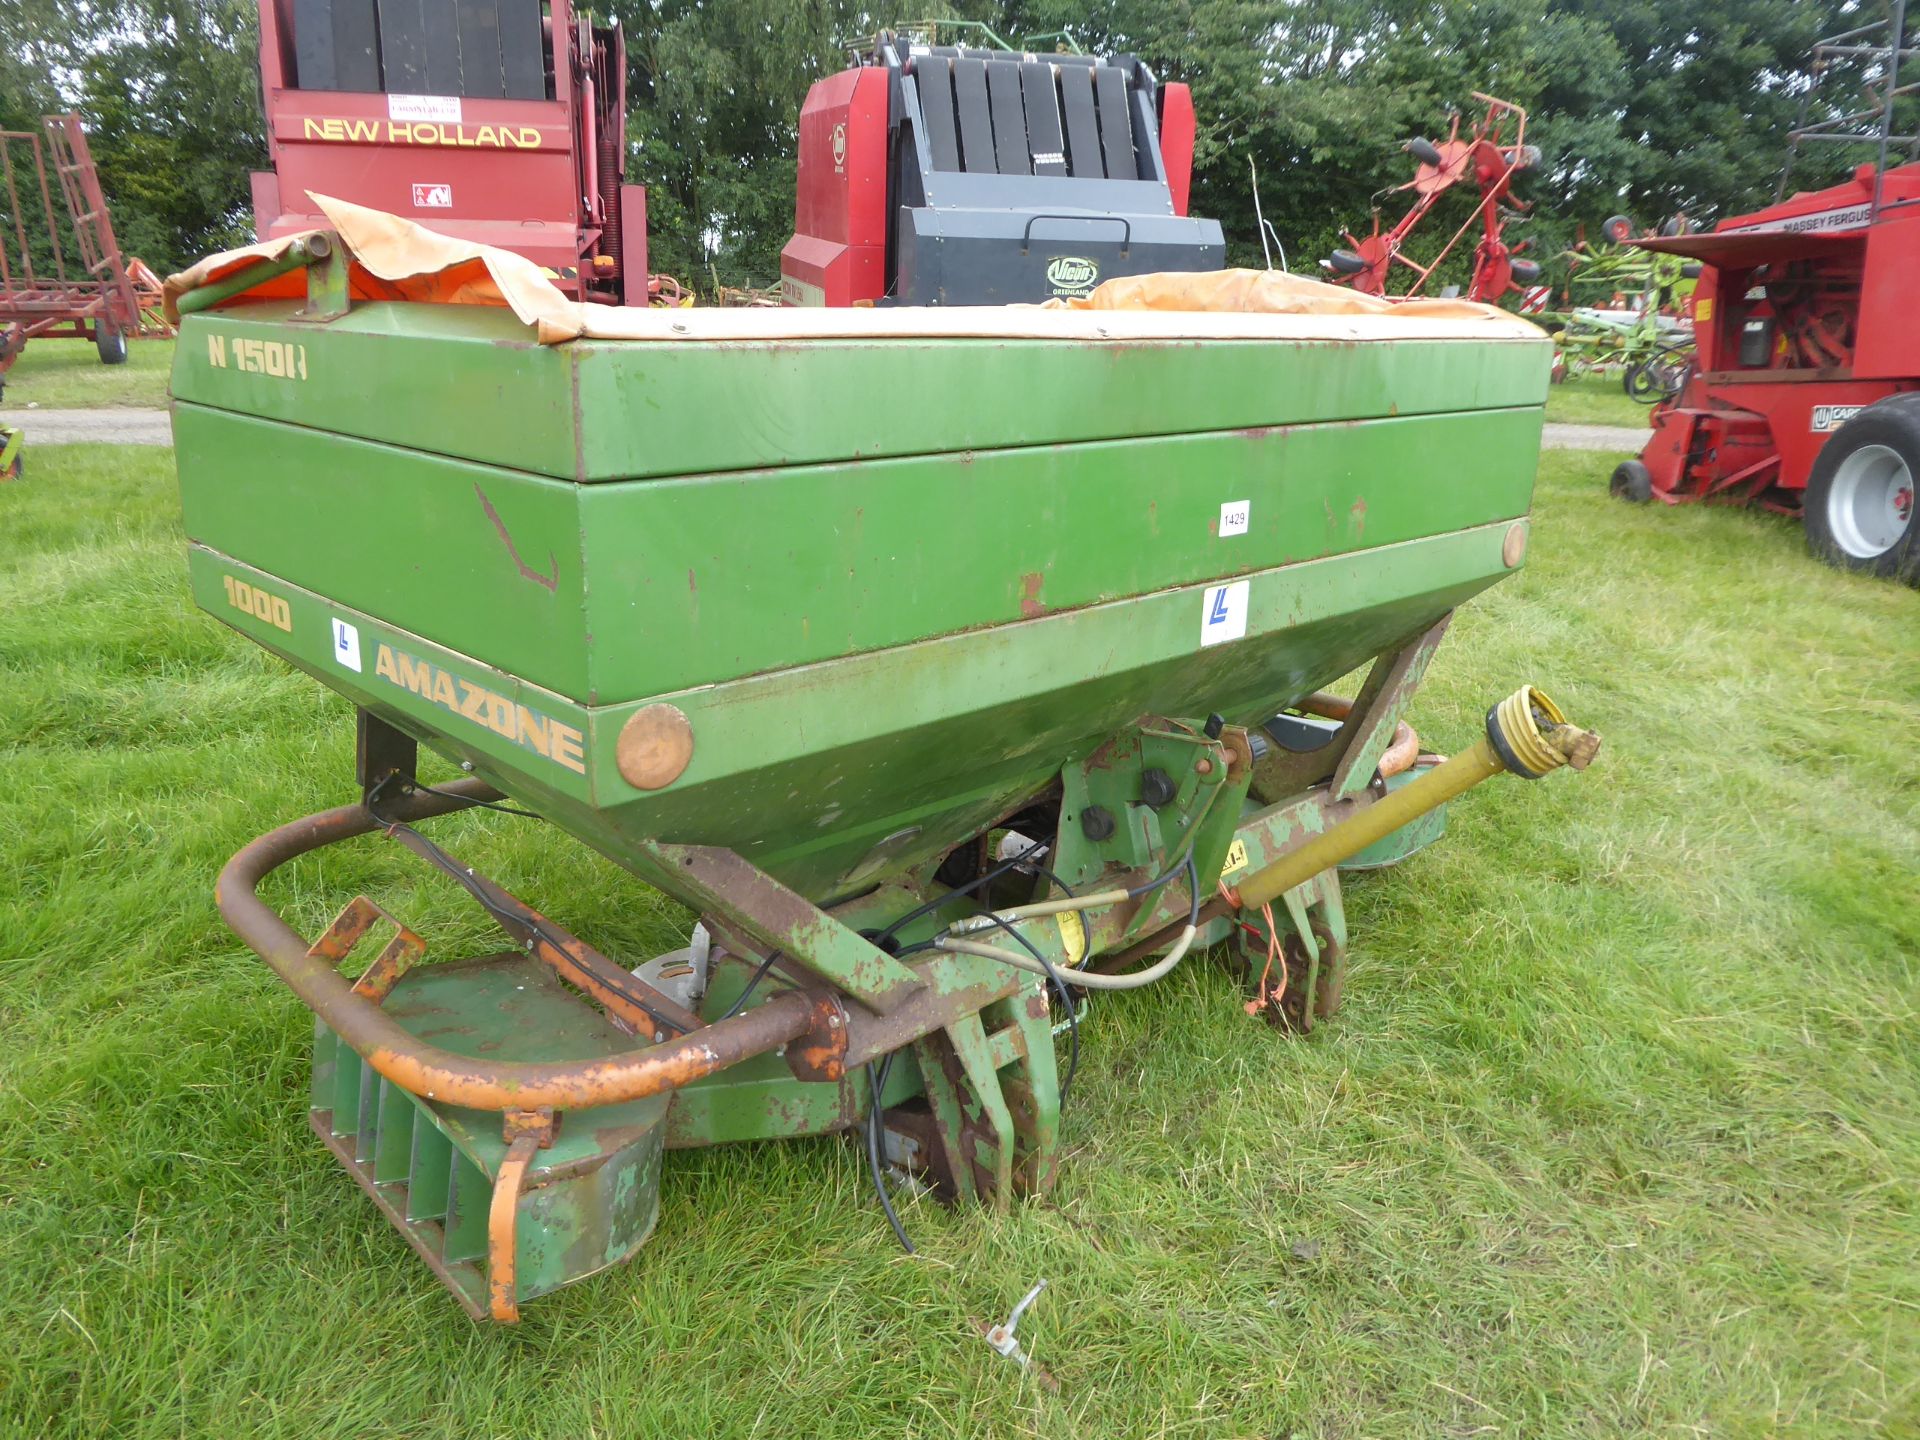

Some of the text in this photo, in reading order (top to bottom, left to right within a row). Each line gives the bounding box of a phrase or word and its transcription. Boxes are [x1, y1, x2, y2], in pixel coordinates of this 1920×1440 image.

[303, 118, 542, 148] NEW HOLLAND
[1783, 217, 1826, 232] MASSEY
[207, 333, 227, 369] N
[1225, 512, 1245, 527] 1429
[223, 574, 293, 633] 1000
[375, 643, 586, 775] AMAZONE
